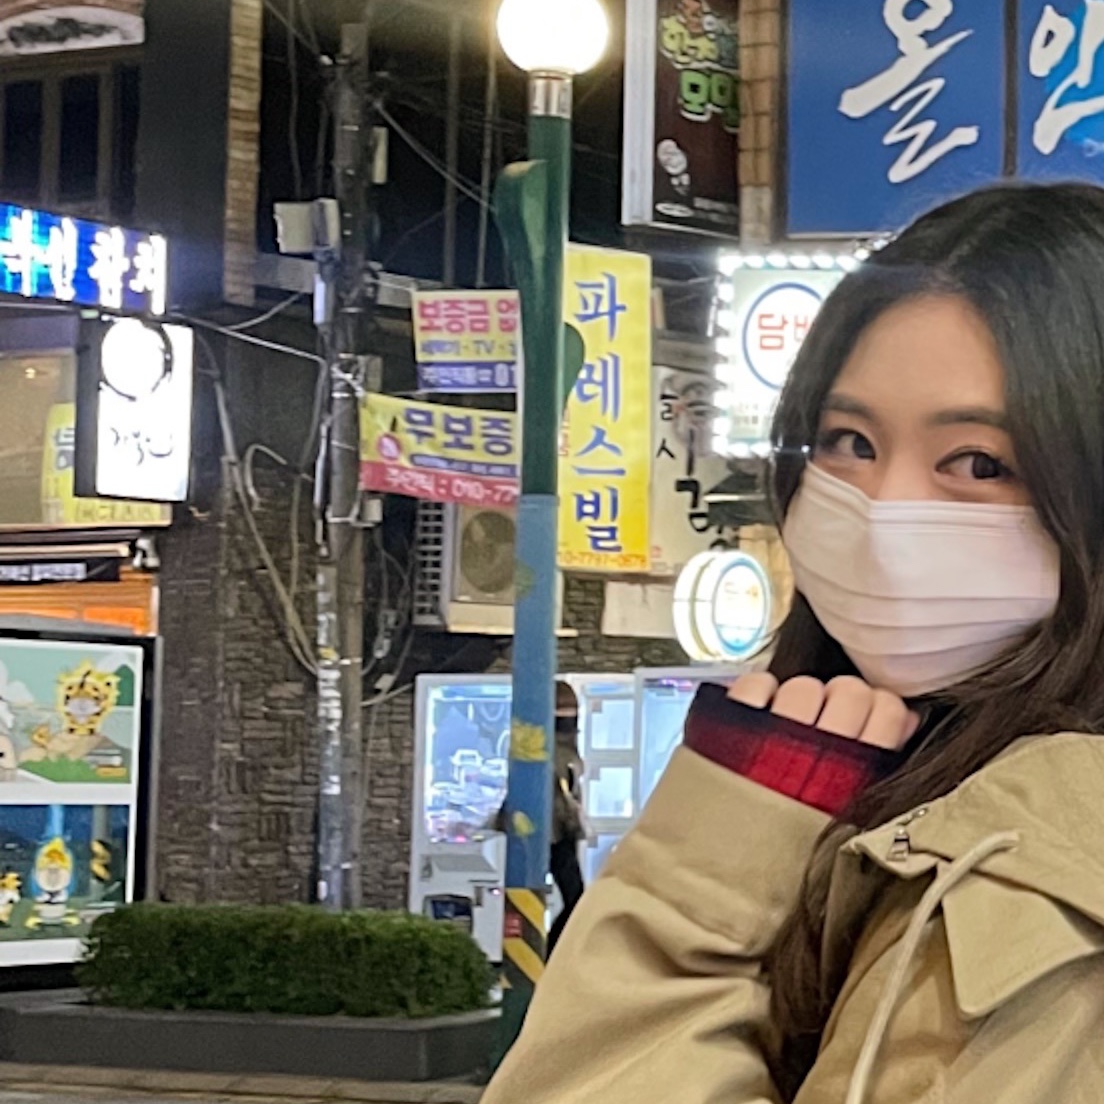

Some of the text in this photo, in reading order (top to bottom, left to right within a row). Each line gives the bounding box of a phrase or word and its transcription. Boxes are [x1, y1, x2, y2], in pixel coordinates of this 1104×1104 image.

[419, 299, 489, 333] 보증금
[405, 408, 513, 456] 무보증
[574, 271, 627, 552] 파레스빌
